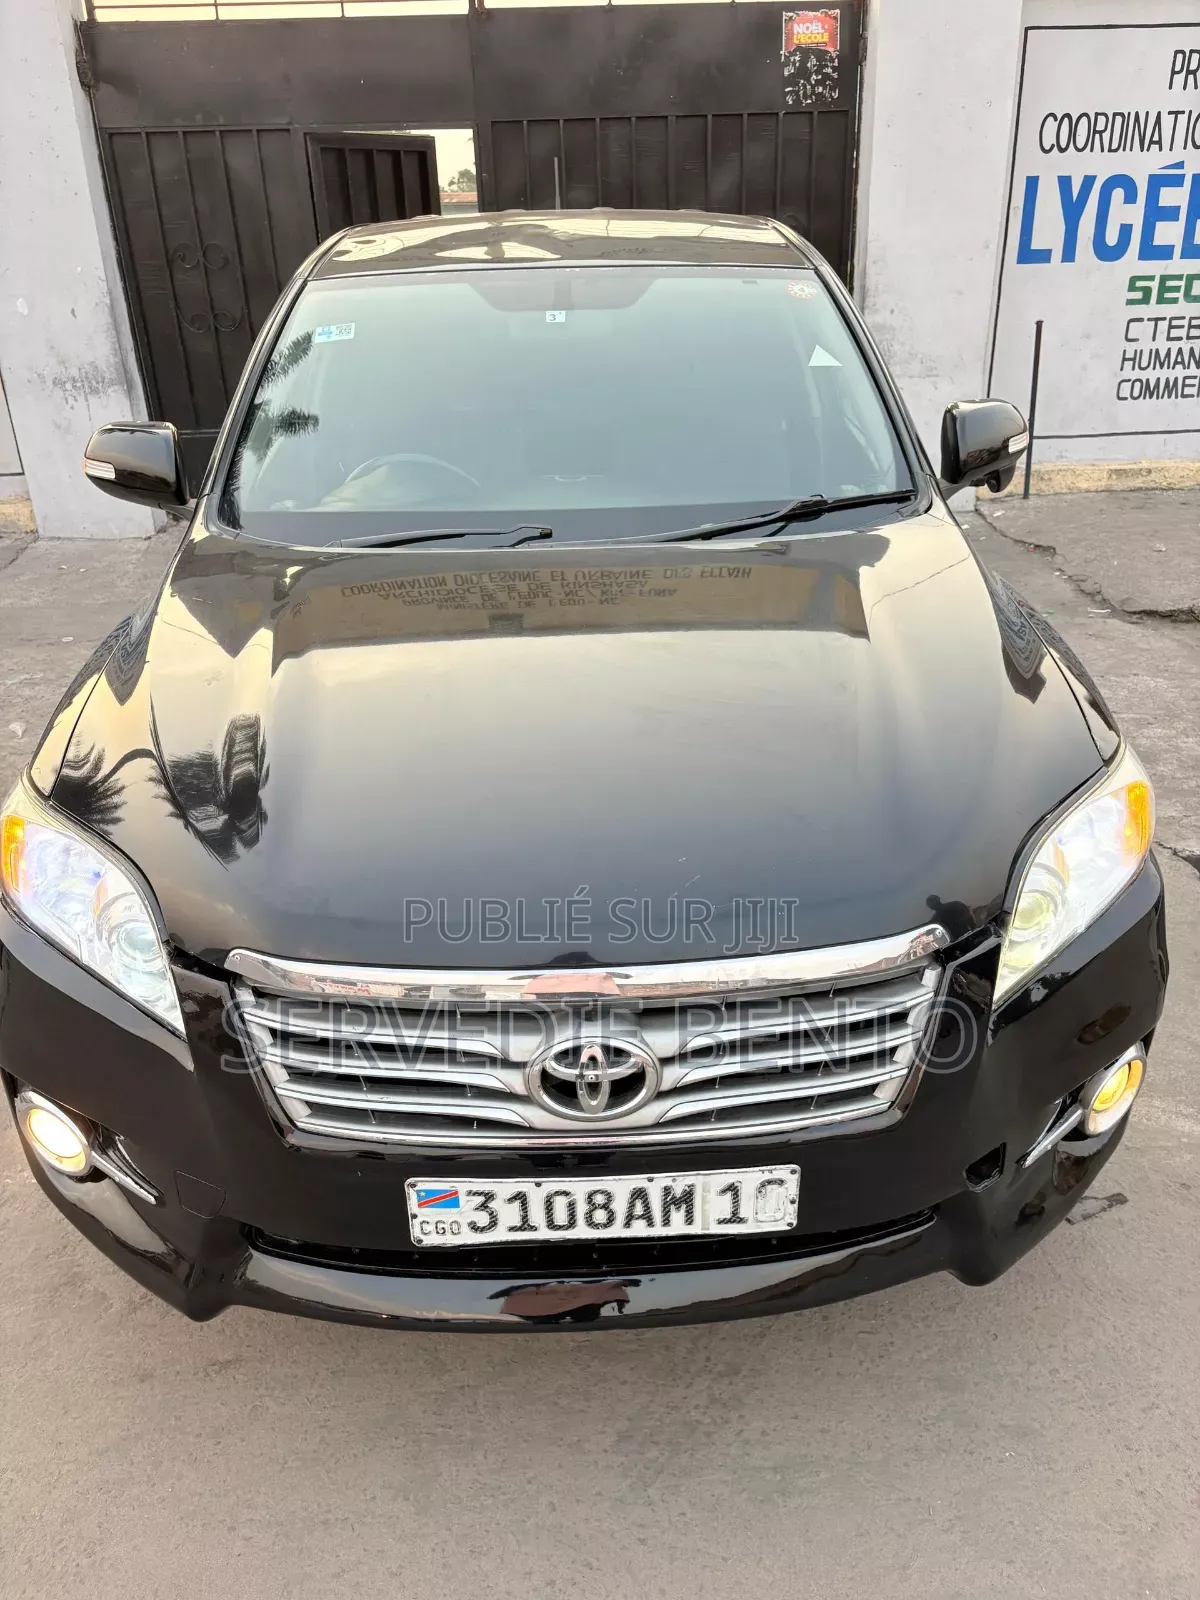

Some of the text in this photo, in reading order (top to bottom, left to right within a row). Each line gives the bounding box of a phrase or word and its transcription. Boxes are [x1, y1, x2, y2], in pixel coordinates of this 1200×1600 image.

[1168, 49, 1200, 90] PR
[549, 313, 557, 322] 3
[1120, 346, 1200, 371] HUMAN
[1116, 375, 1200, 401] COMME
[420, 1220, 462, 1236] CGO
